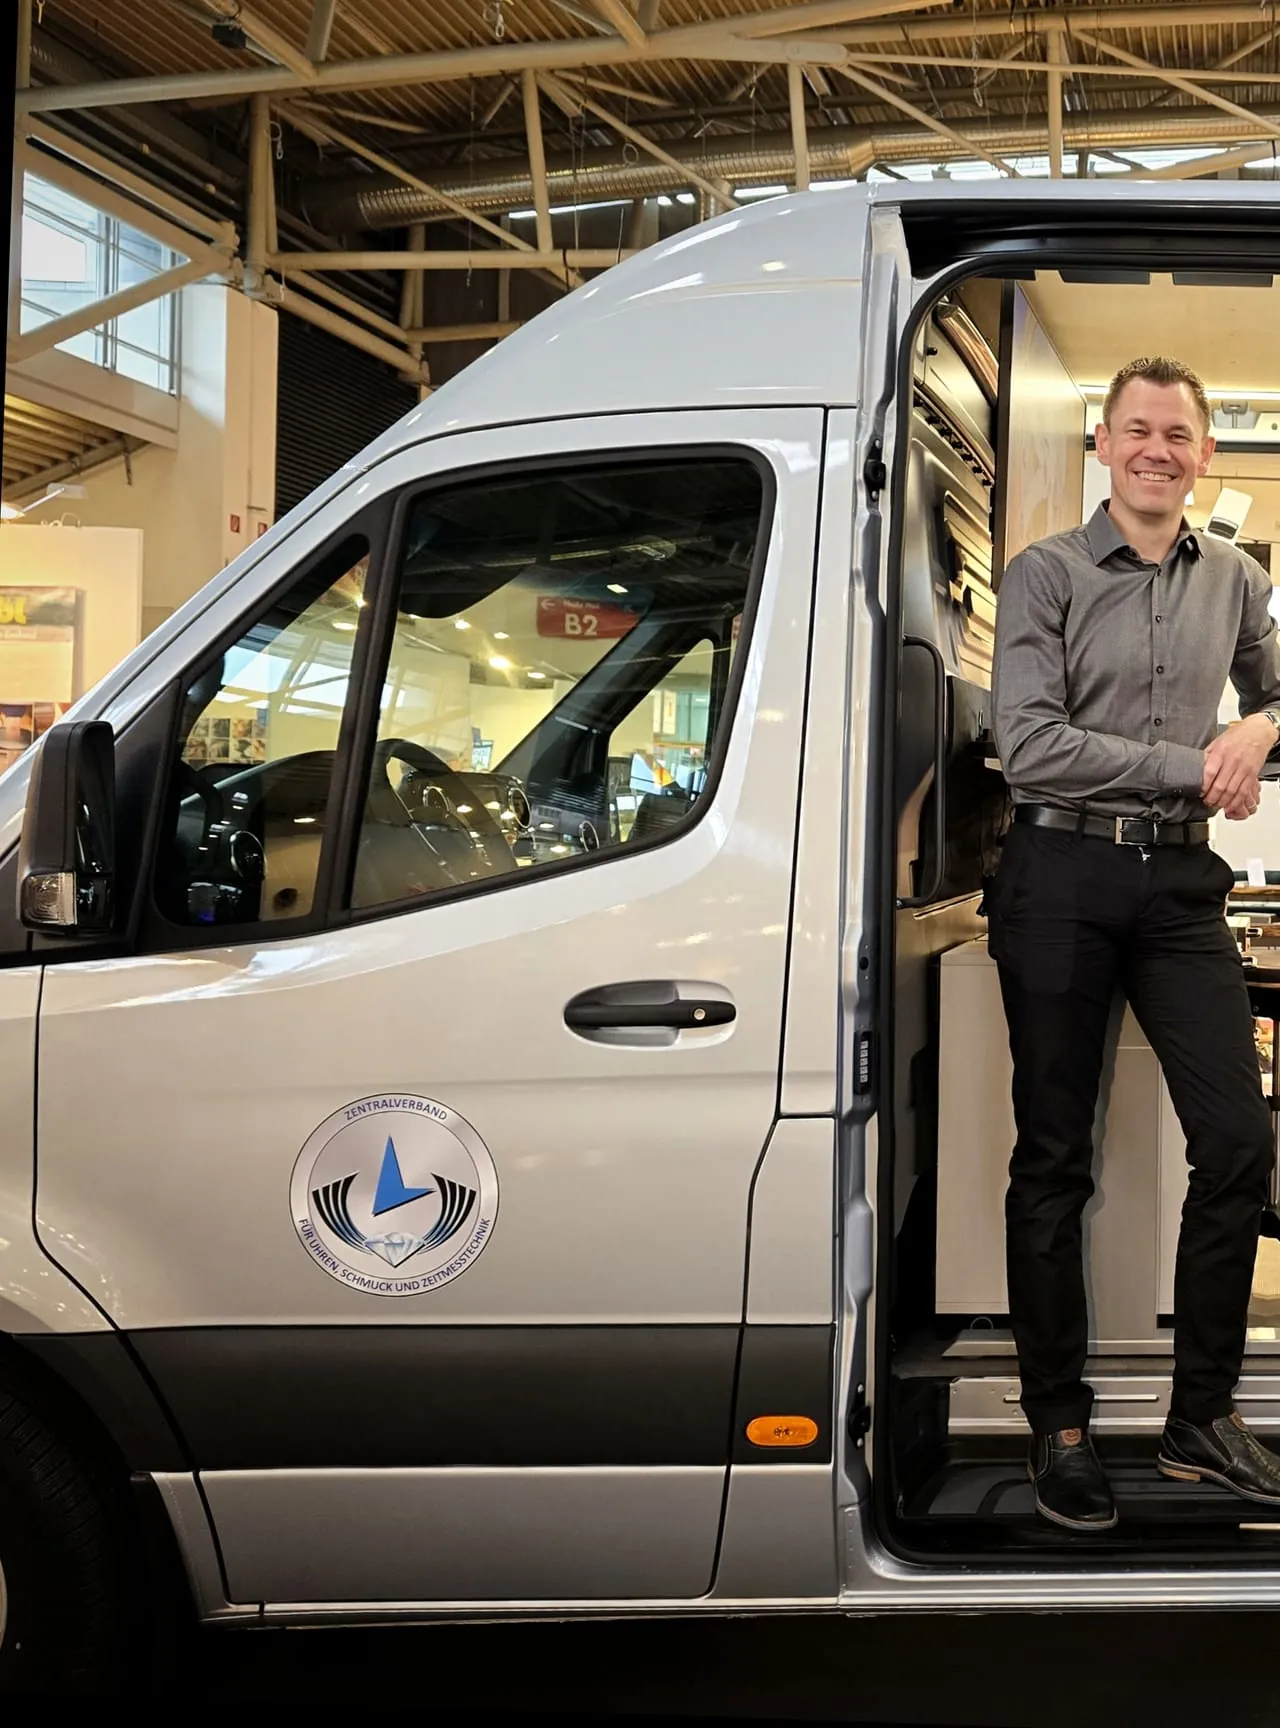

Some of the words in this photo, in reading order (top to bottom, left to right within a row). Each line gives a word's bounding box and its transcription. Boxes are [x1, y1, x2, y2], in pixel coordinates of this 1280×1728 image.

[565, 613, 598, 636] B2
[344, 1098, 448, 1121] ZENTRALVERBAND
[298, 1217, 314, 1242] FÜR
[308, 1239, 340, 1274] UHREN,
[339, 1269, 394, 1292] SCHMUCK
[395, 1281, 420, 1292] UND
[421, 1217, 491, 1288] ZEITMESSTECHNIK
